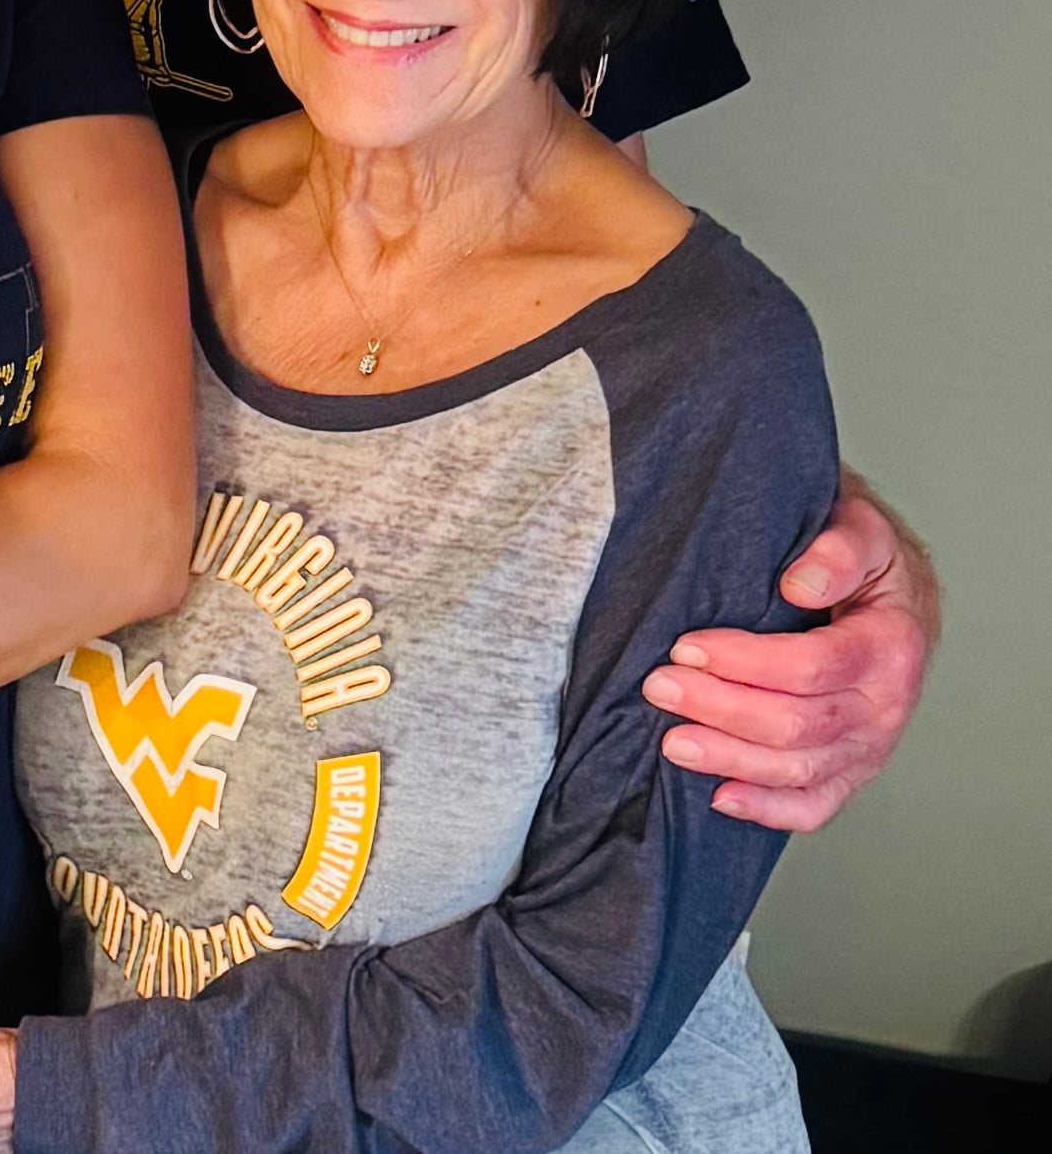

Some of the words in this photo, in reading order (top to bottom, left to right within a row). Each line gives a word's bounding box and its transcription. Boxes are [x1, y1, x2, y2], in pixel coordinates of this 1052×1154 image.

[189, 491, 391, 718] VIRGINIA
[54, 638, 258, 875] WV
[297, 765, 366, 920] DEPARTMENT
